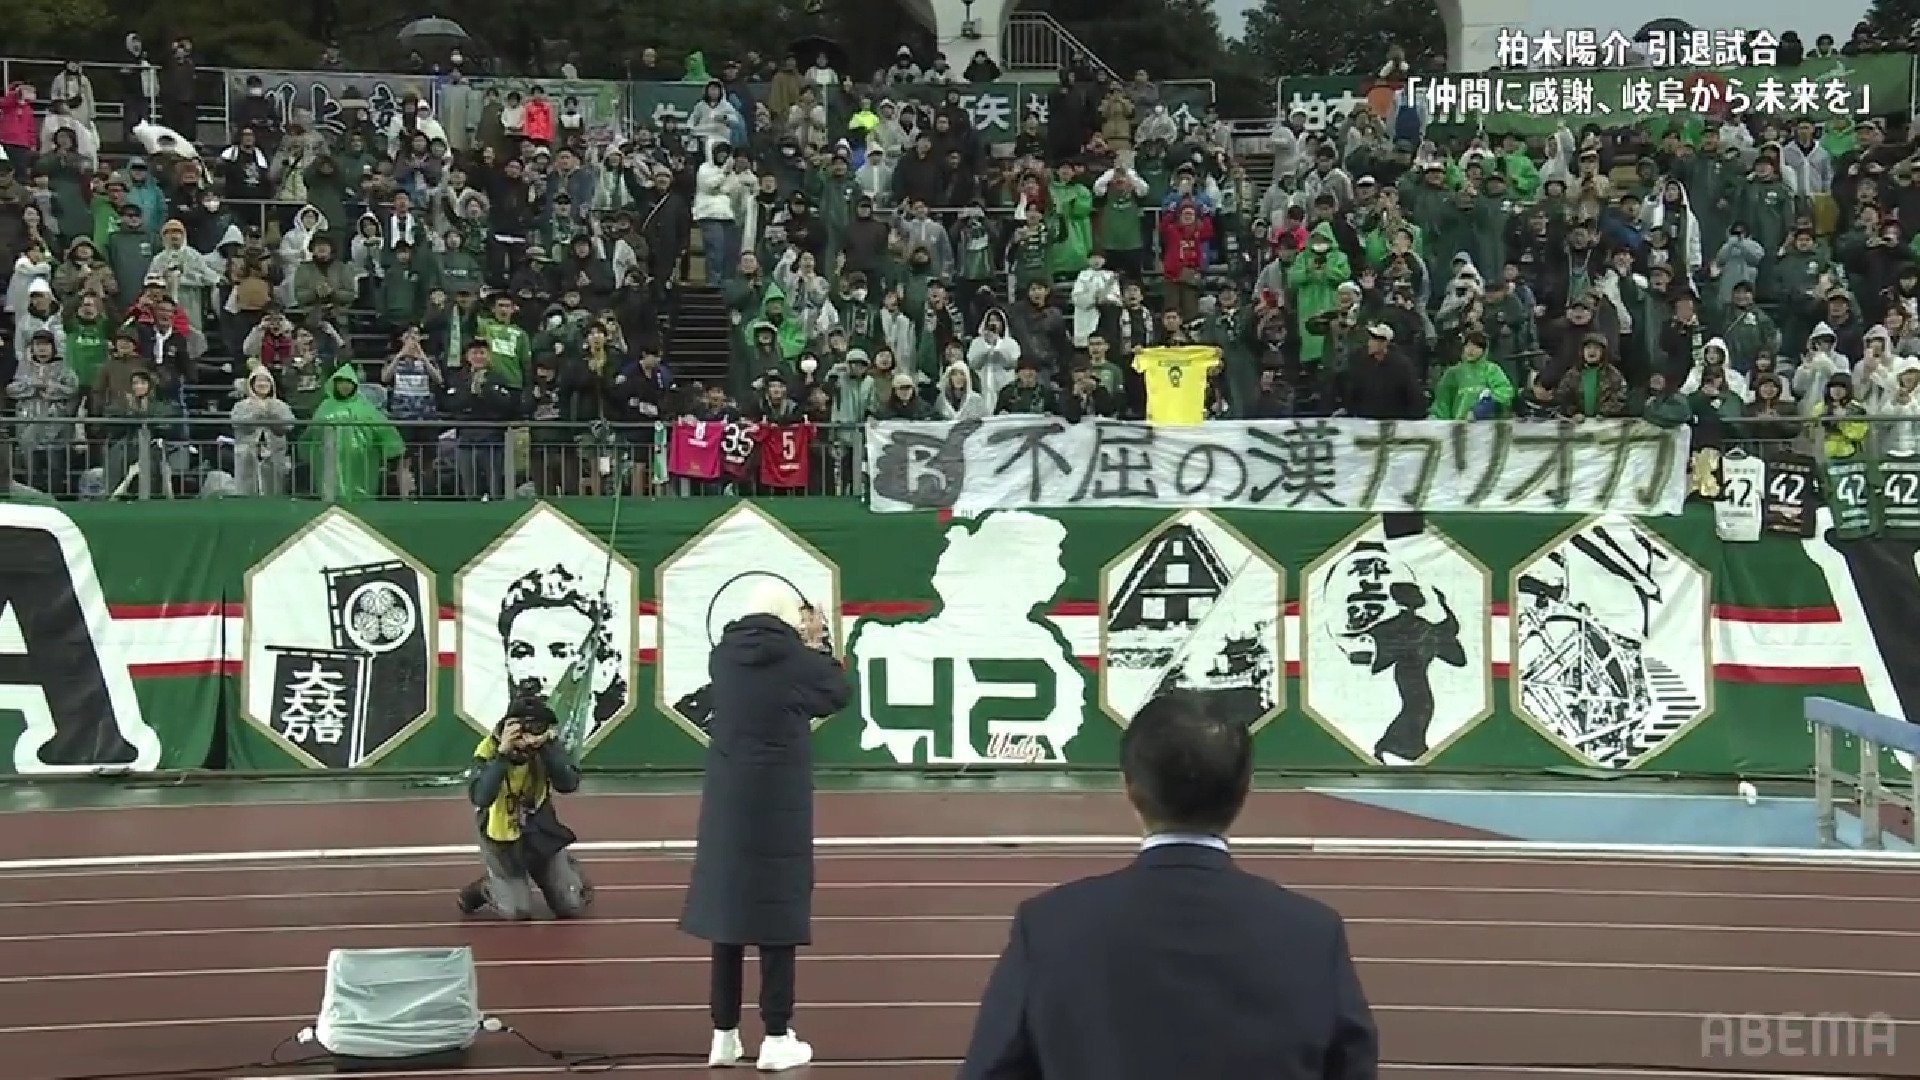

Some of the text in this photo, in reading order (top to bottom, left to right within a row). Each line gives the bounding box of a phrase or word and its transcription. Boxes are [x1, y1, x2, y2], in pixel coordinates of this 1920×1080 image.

[721, 423, 757, 456] 35
[782, 431, 796, 460] 5
[1769, 473, 1806, 505] 42
[1836, 474, 1868, 506] 42
[1884, 473, 1920, 504] 42
[868, 657, 1057, 760] 42
